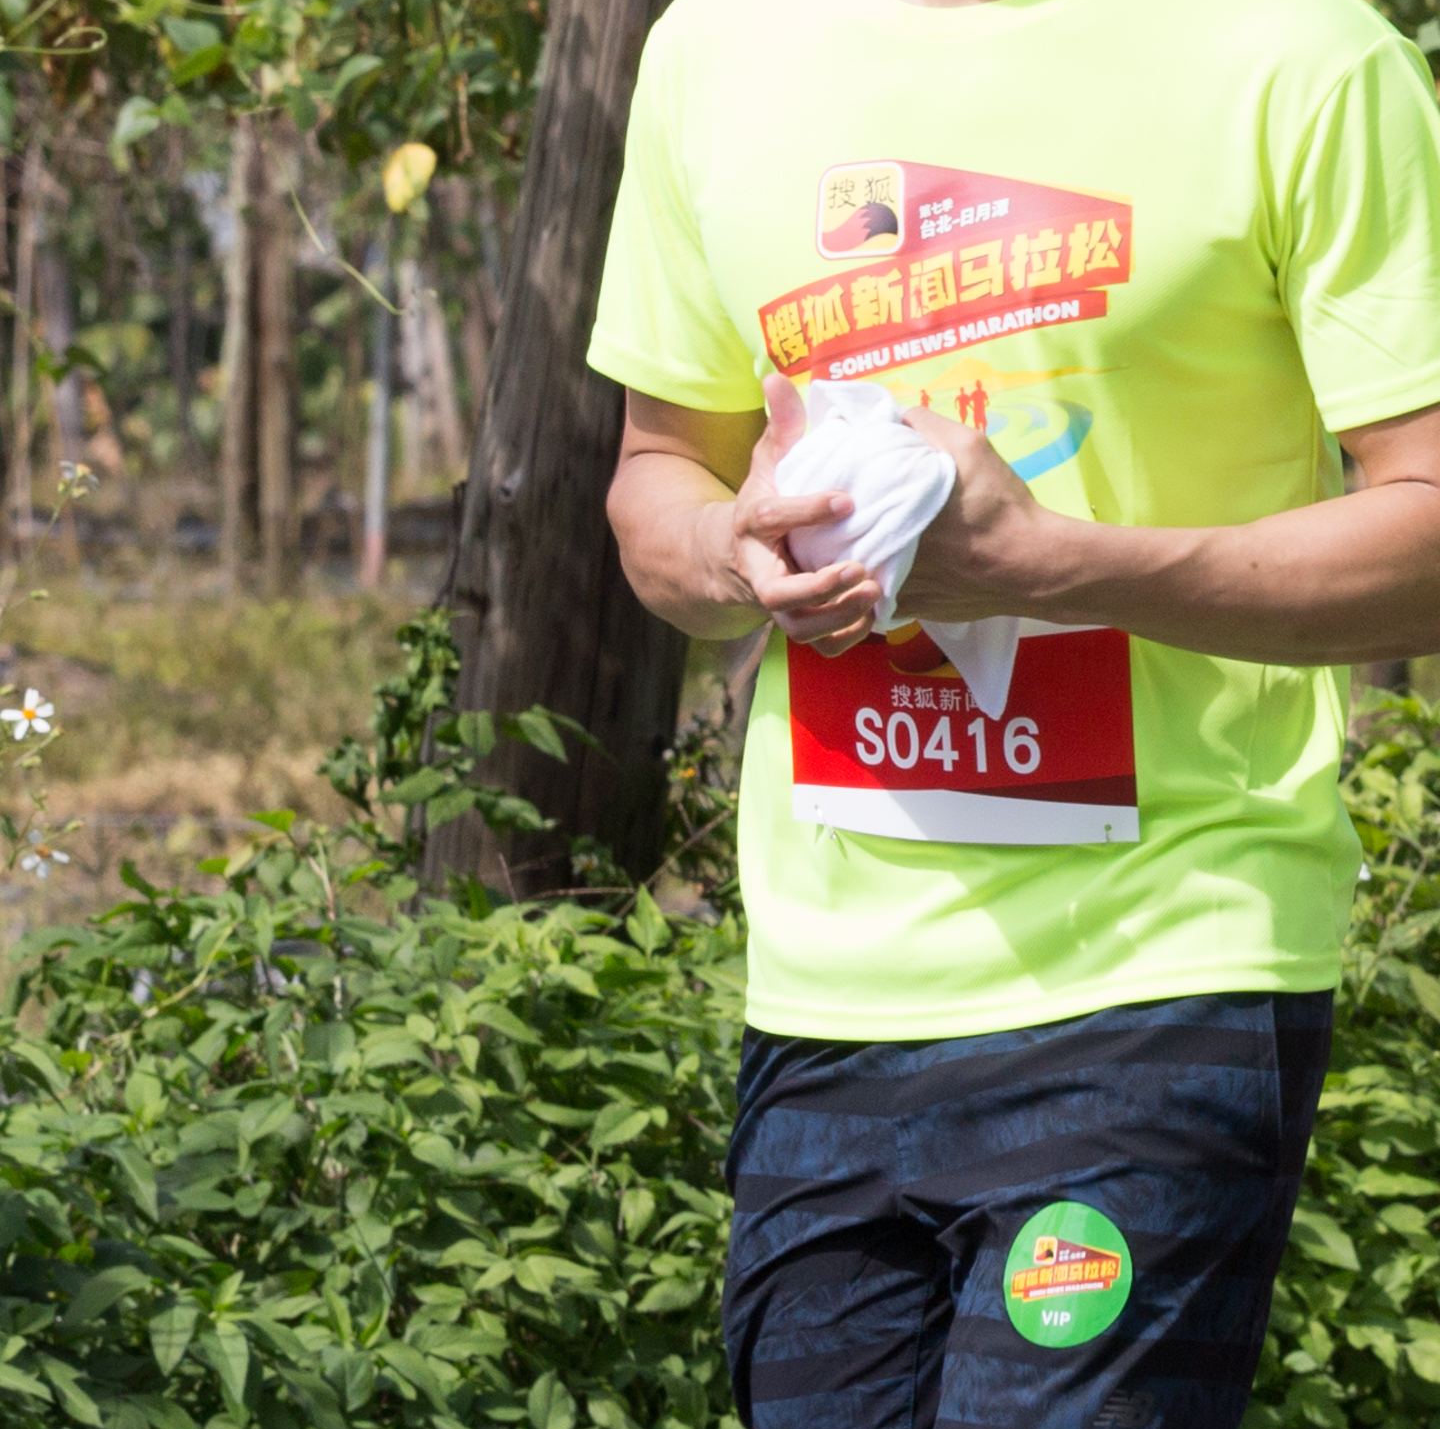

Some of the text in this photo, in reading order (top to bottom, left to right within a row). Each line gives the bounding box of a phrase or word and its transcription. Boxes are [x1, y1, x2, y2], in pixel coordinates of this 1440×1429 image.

[828, 176, 894, 210] 搜狐
[919, 198, 953, 218] 第七季
[766, 217, 1123, 368] 搜狐新闻马拉松
[829, 299, 1079, 379] SOHU NEWS MARATHON
[855, 707, 1041, 775] S0416
[1041, 1310, 1071, 1326] VIP
